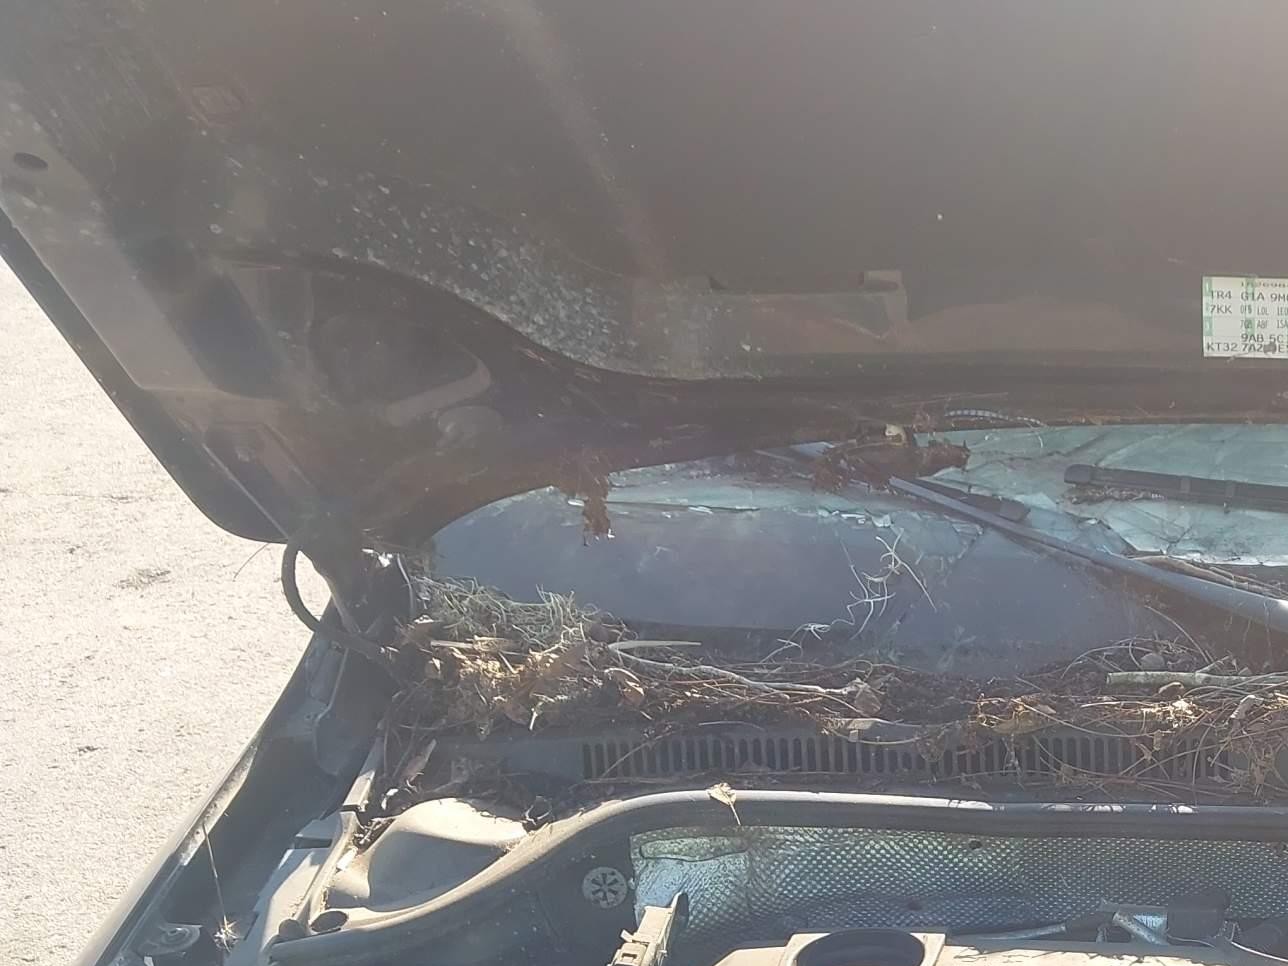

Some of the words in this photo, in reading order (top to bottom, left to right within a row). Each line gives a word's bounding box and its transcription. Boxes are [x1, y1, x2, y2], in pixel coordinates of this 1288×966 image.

[1240, 291, 1265, 301] G1A
[1210, 304, 1232, 314] 7KK
[1241, 333, 1264, 343] 9AB
[1207, 342, 1238, 352] KT32
